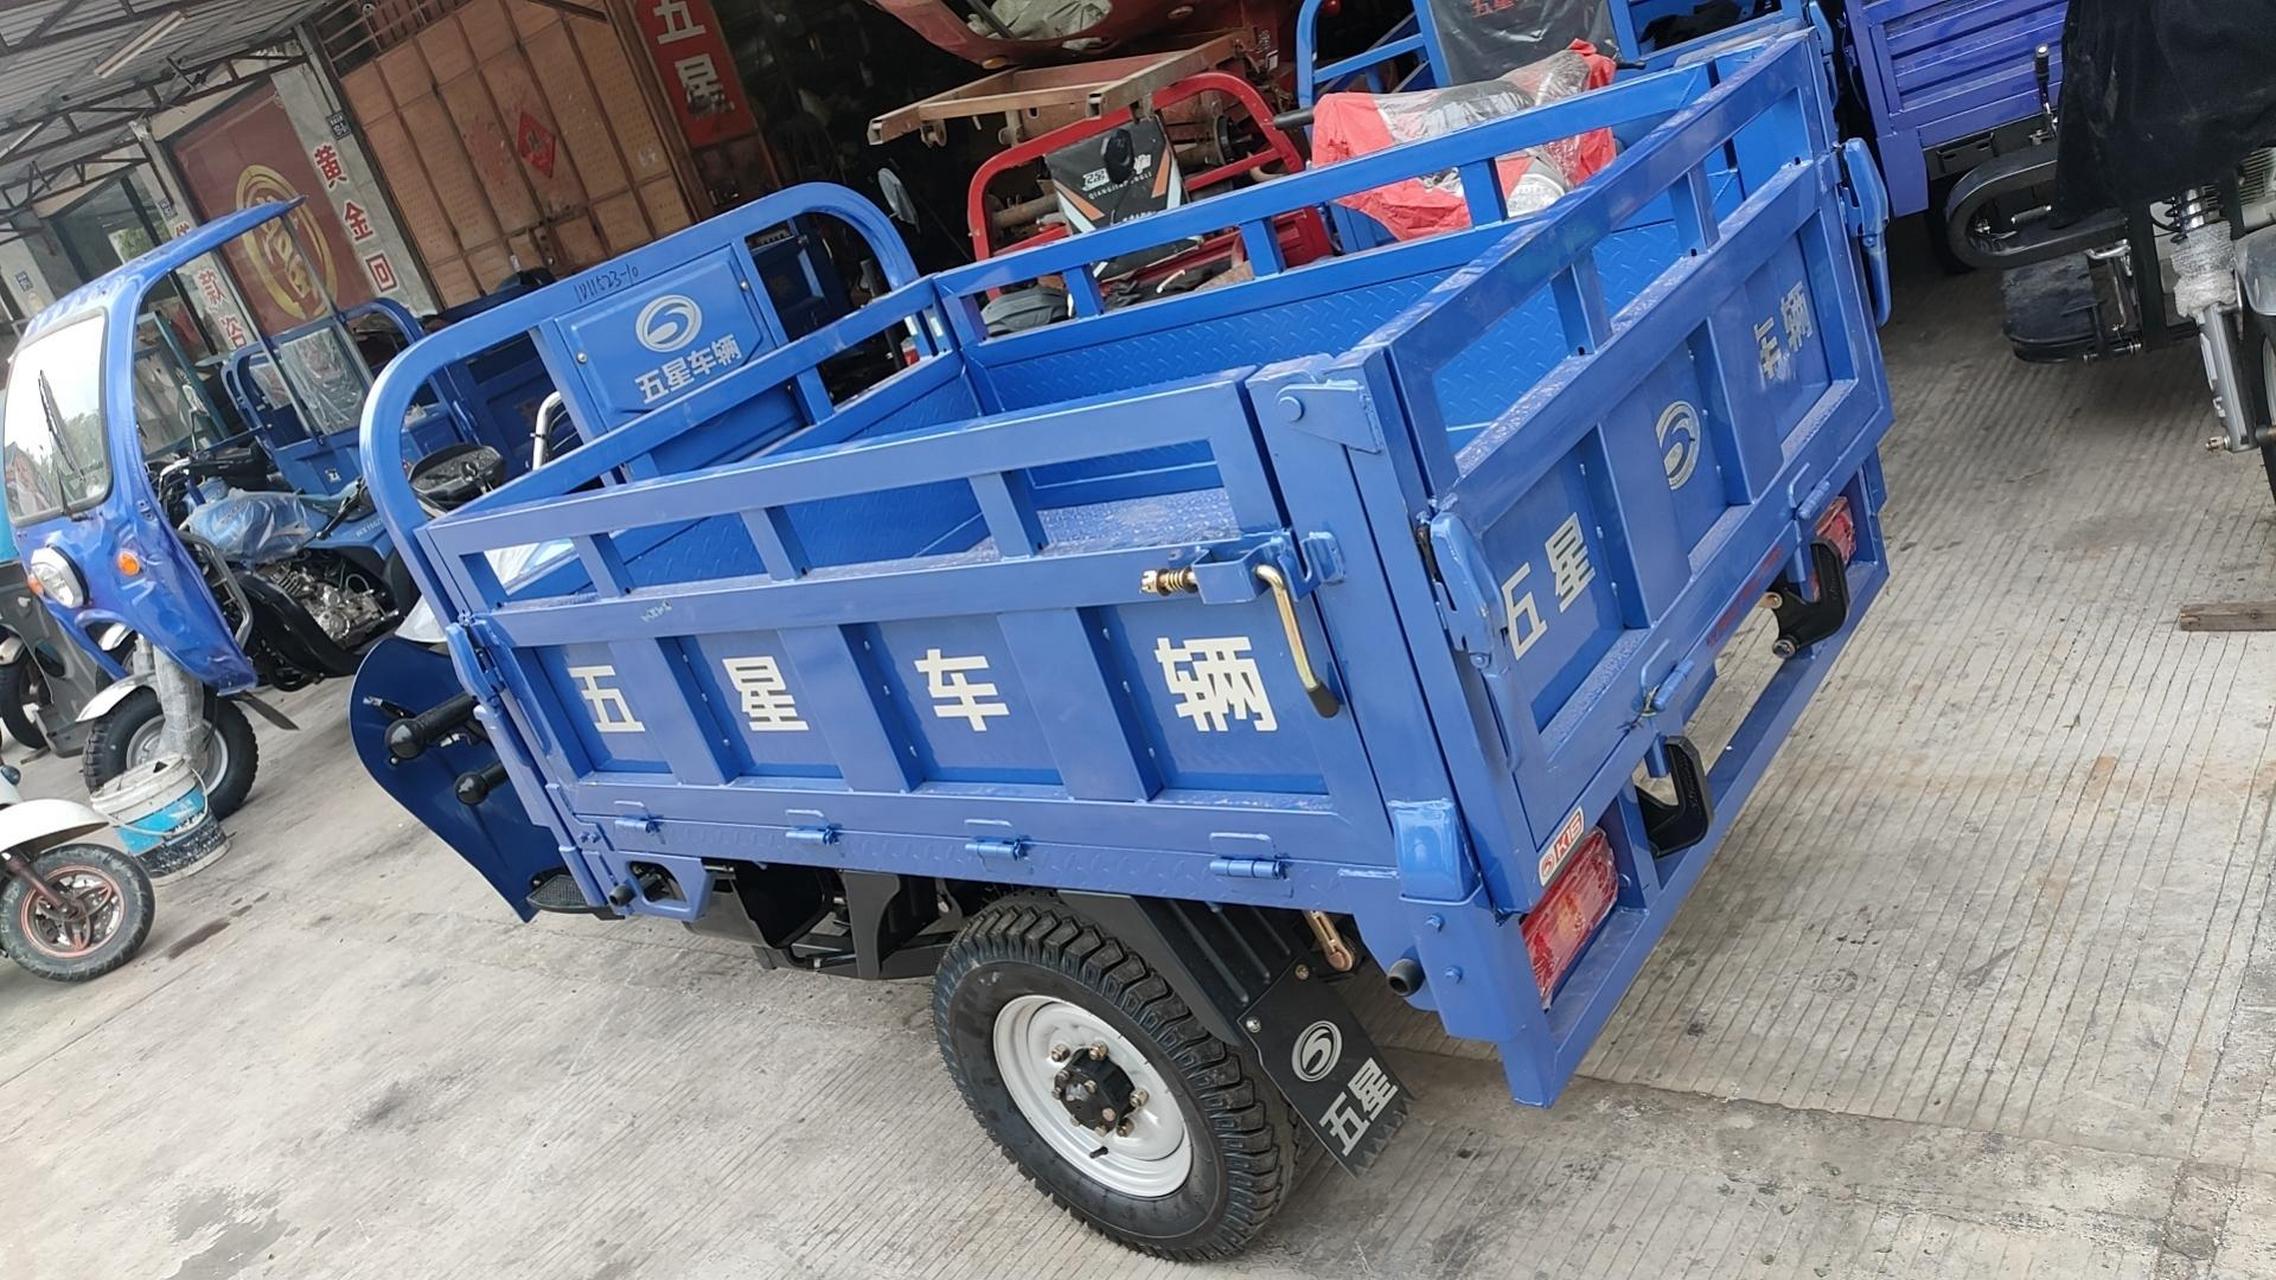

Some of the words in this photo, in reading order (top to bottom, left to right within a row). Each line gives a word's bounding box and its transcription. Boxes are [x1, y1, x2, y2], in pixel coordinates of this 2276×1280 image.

[634, 333, 743, 404] 五星车辆
[1753, 280, 1814, 381] 车辆
[567, 635, 1279, 733] 五星车辆
[1318, 1056, 1399, 1156] 五星
